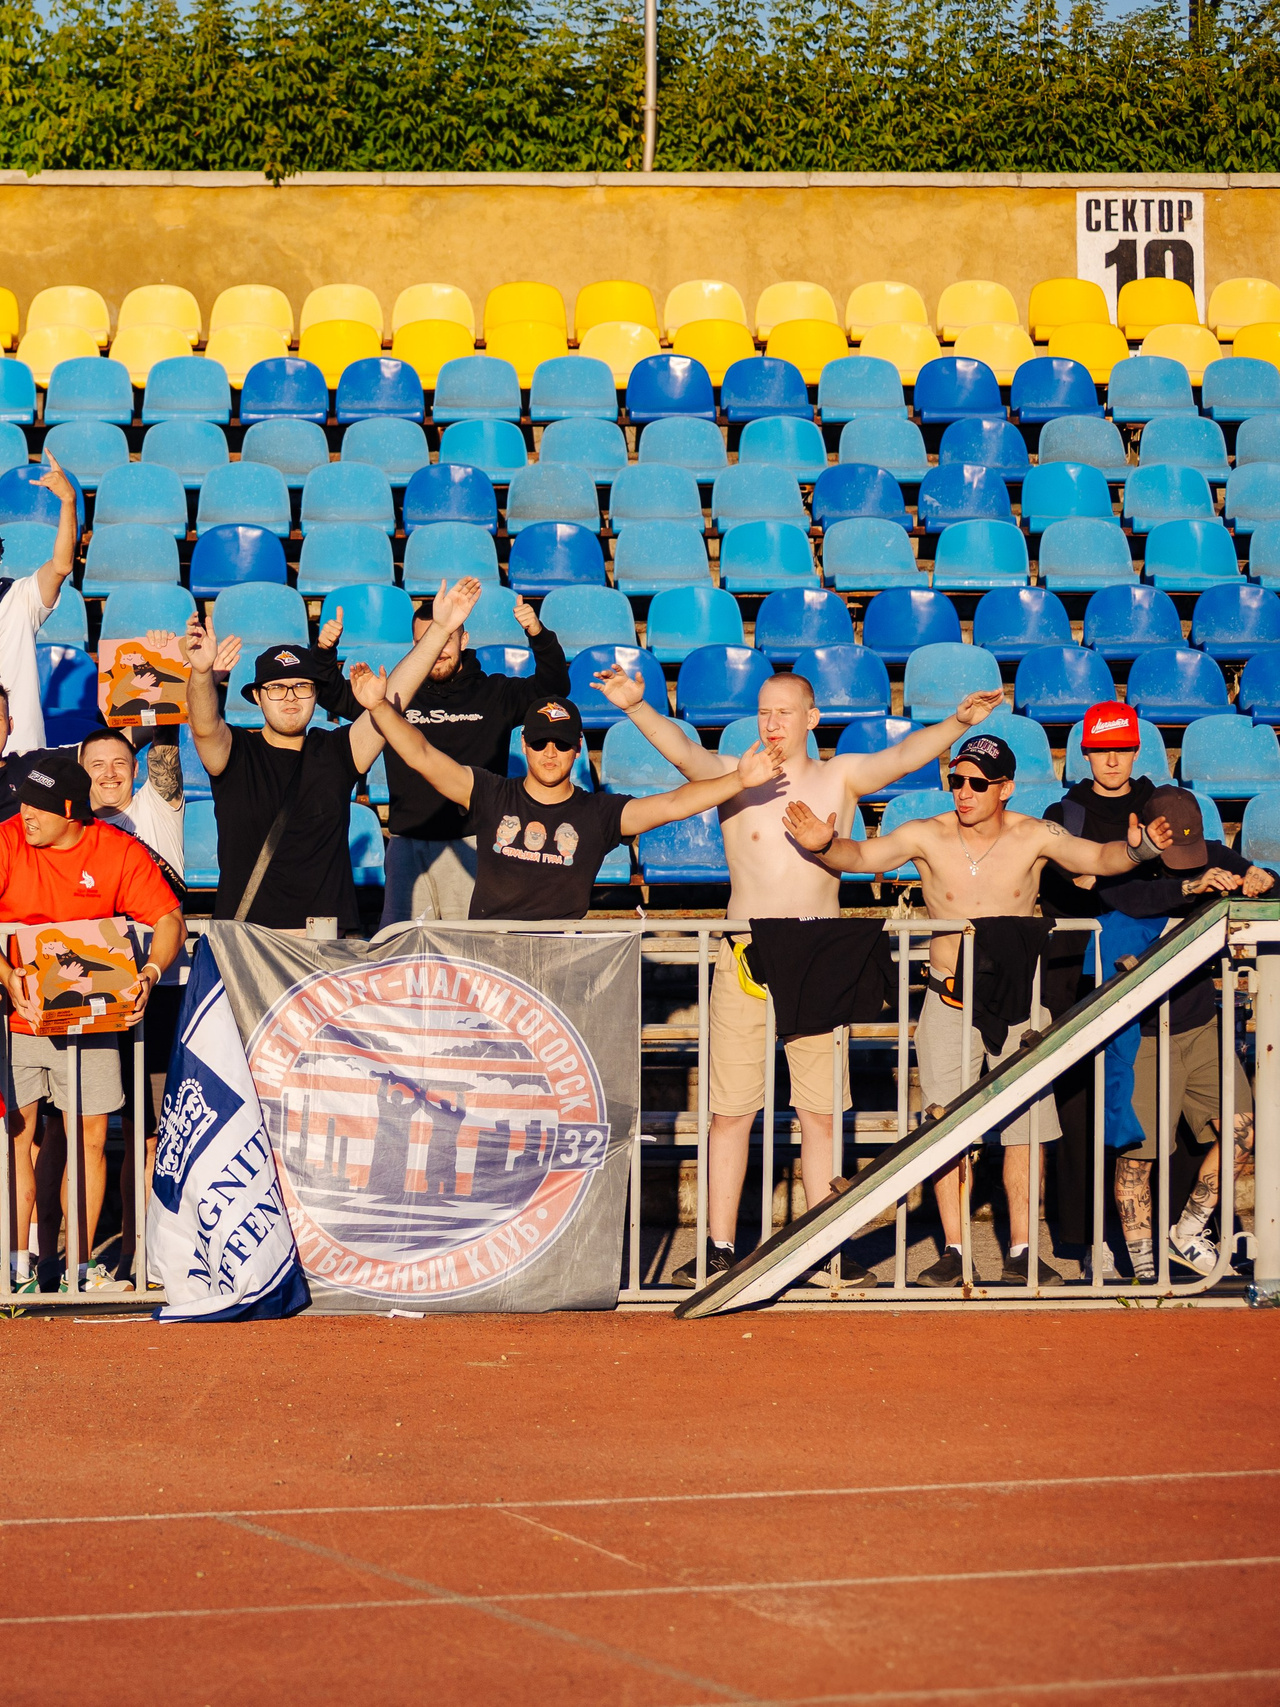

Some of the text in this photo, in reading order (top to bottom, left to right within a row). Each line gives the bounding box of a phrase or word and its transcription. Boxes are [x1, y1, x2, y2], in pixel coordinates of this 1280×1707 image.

[1085, 198, 1193, 233] СЕКТОР
[1104, 239, 1196, 300] 10
[252, 967, 592, 1116] МЕТАЛЛУРГ-МАГНИТОГОРСК
[561, 1128, 604, 1167] 32
[464, 1216, 540, 1280] КЛУБ
